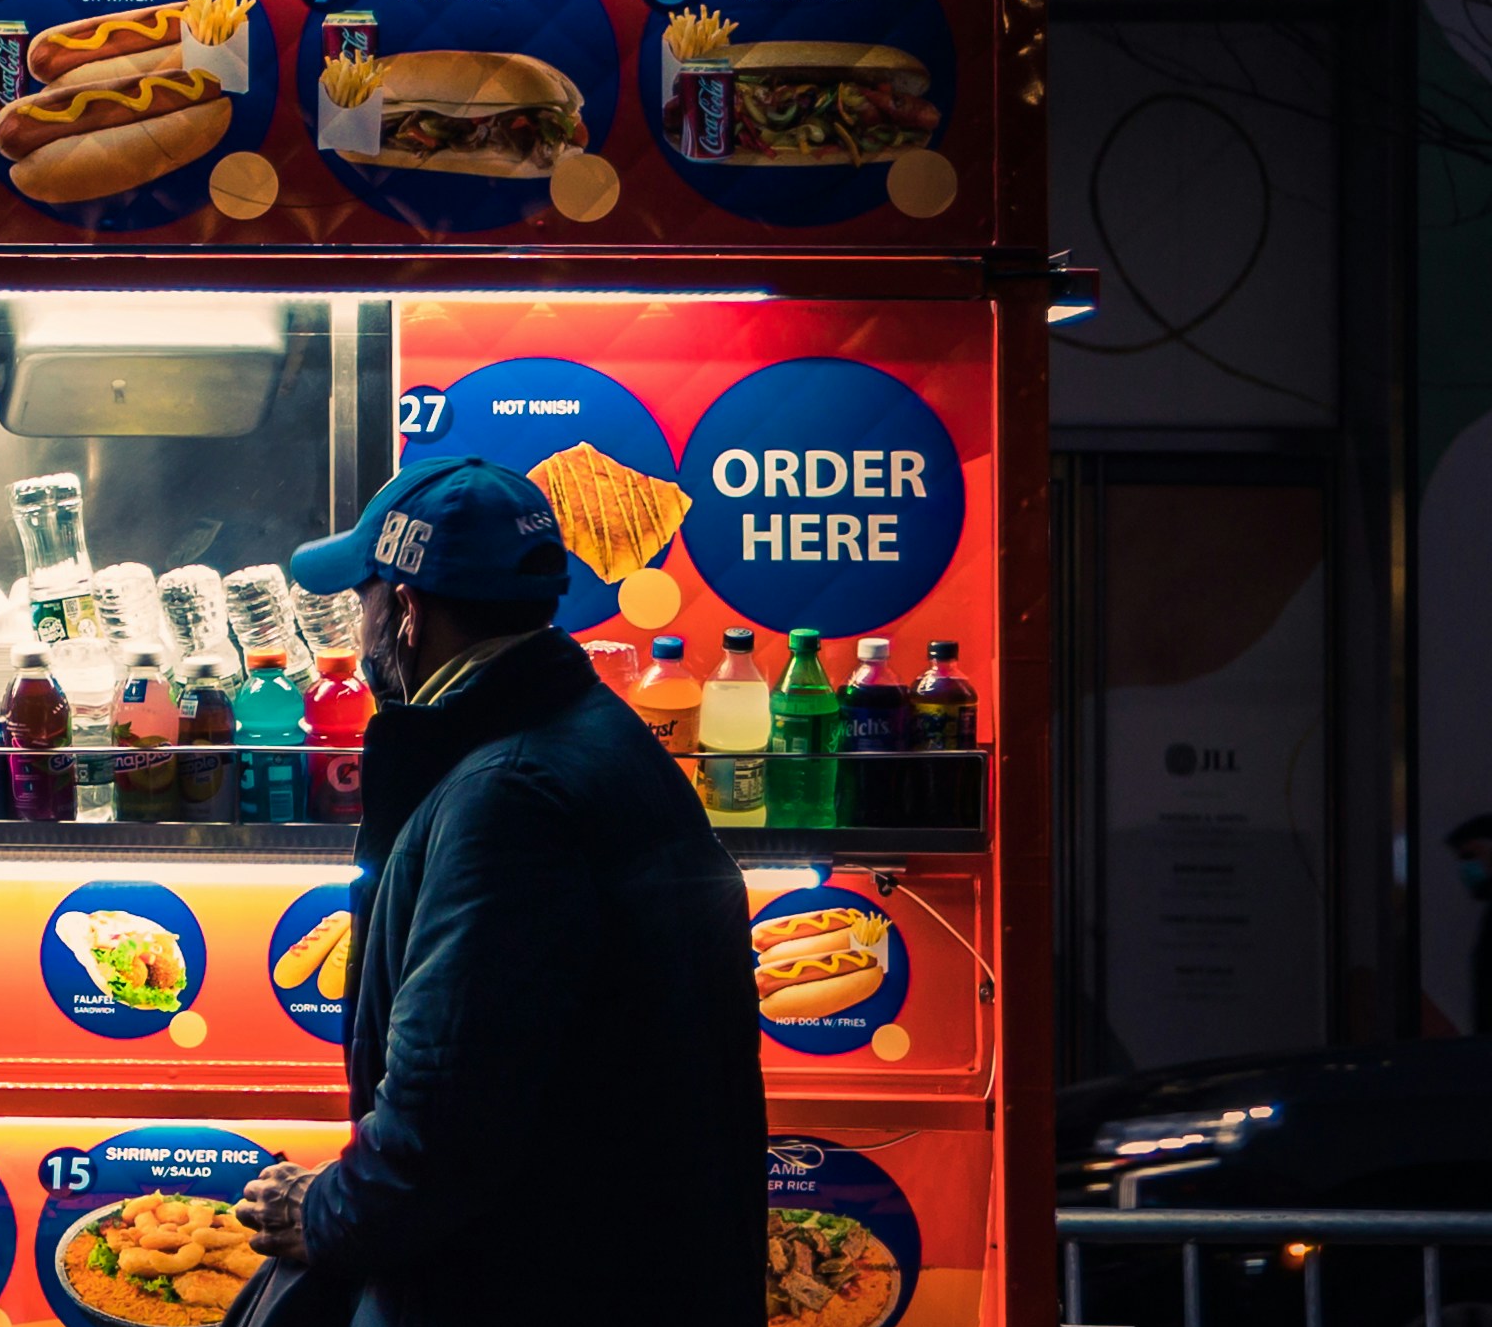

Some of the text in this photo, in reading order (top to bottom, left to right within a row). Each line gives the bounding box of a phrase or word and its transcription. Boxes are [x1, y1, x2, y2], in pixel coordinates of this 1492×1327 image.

[399, 395, 447, 433] 27
[492, 399, 581, 416] HOT KNISH
[712, 448, 928, 499] ORDER
[373, 508, 435, 575] 86
[742, 514, 901, 562] HERE
[327, 756, 361, 793] G
[73, 994, 116, 1005] FALAFEL
[73, 1006, 116, 1015] SANDWICH
[290, 1003, 343, 1015] CORN DOG
[775, 1016, 867, 1028] HOT DOG W/FRIES
[105, 1146, 259, 1165] SHRIMP OVER RICE
[45, 1156, 92, 1191] 15
[151, 1164, 212, 1179] W/SALAD
[768, 1163, 808, 1176] AMB
[787, 1179, 817, 1192] RICE
